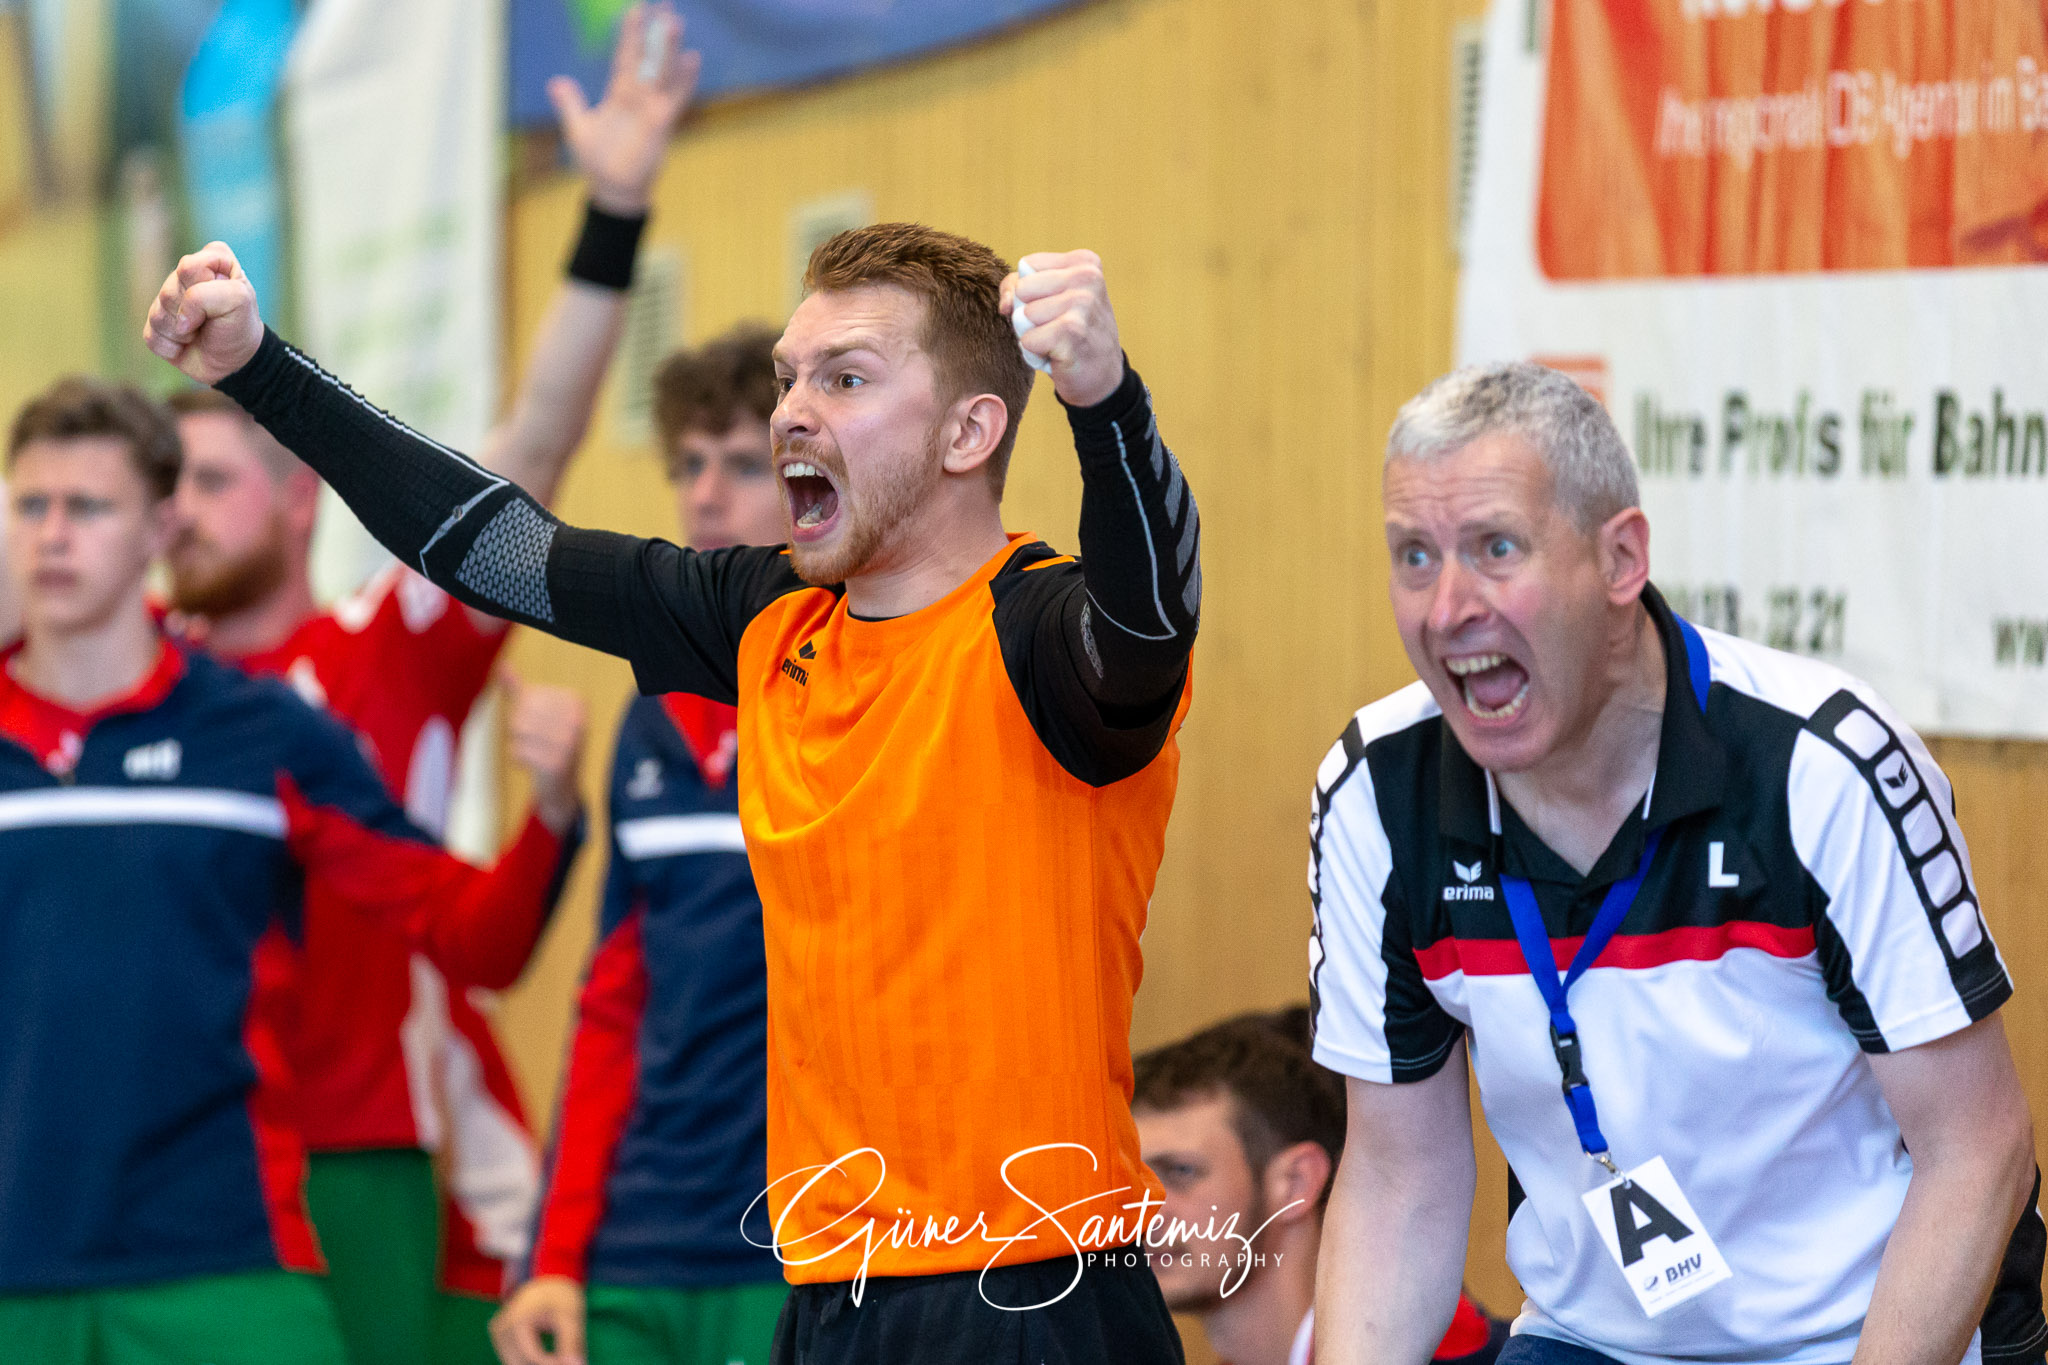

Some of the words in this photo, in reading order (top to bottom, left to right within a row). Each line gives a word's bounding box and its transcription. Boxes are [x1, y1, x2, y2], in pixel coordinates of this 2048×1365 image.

[1635, 388, 1704, 476] Ihre
[1720, 386, 1841, 477] Profis
[1860, 386, 1914, 477] für
[1934, 386, 2046, 475] Bahn
[1708, 842, 1739, 887] L
[1443, 883, 1495, 901] erima
[1610, 1178, 1695, 1268] A
[1665, 1253, 1702, 1283] BHV
